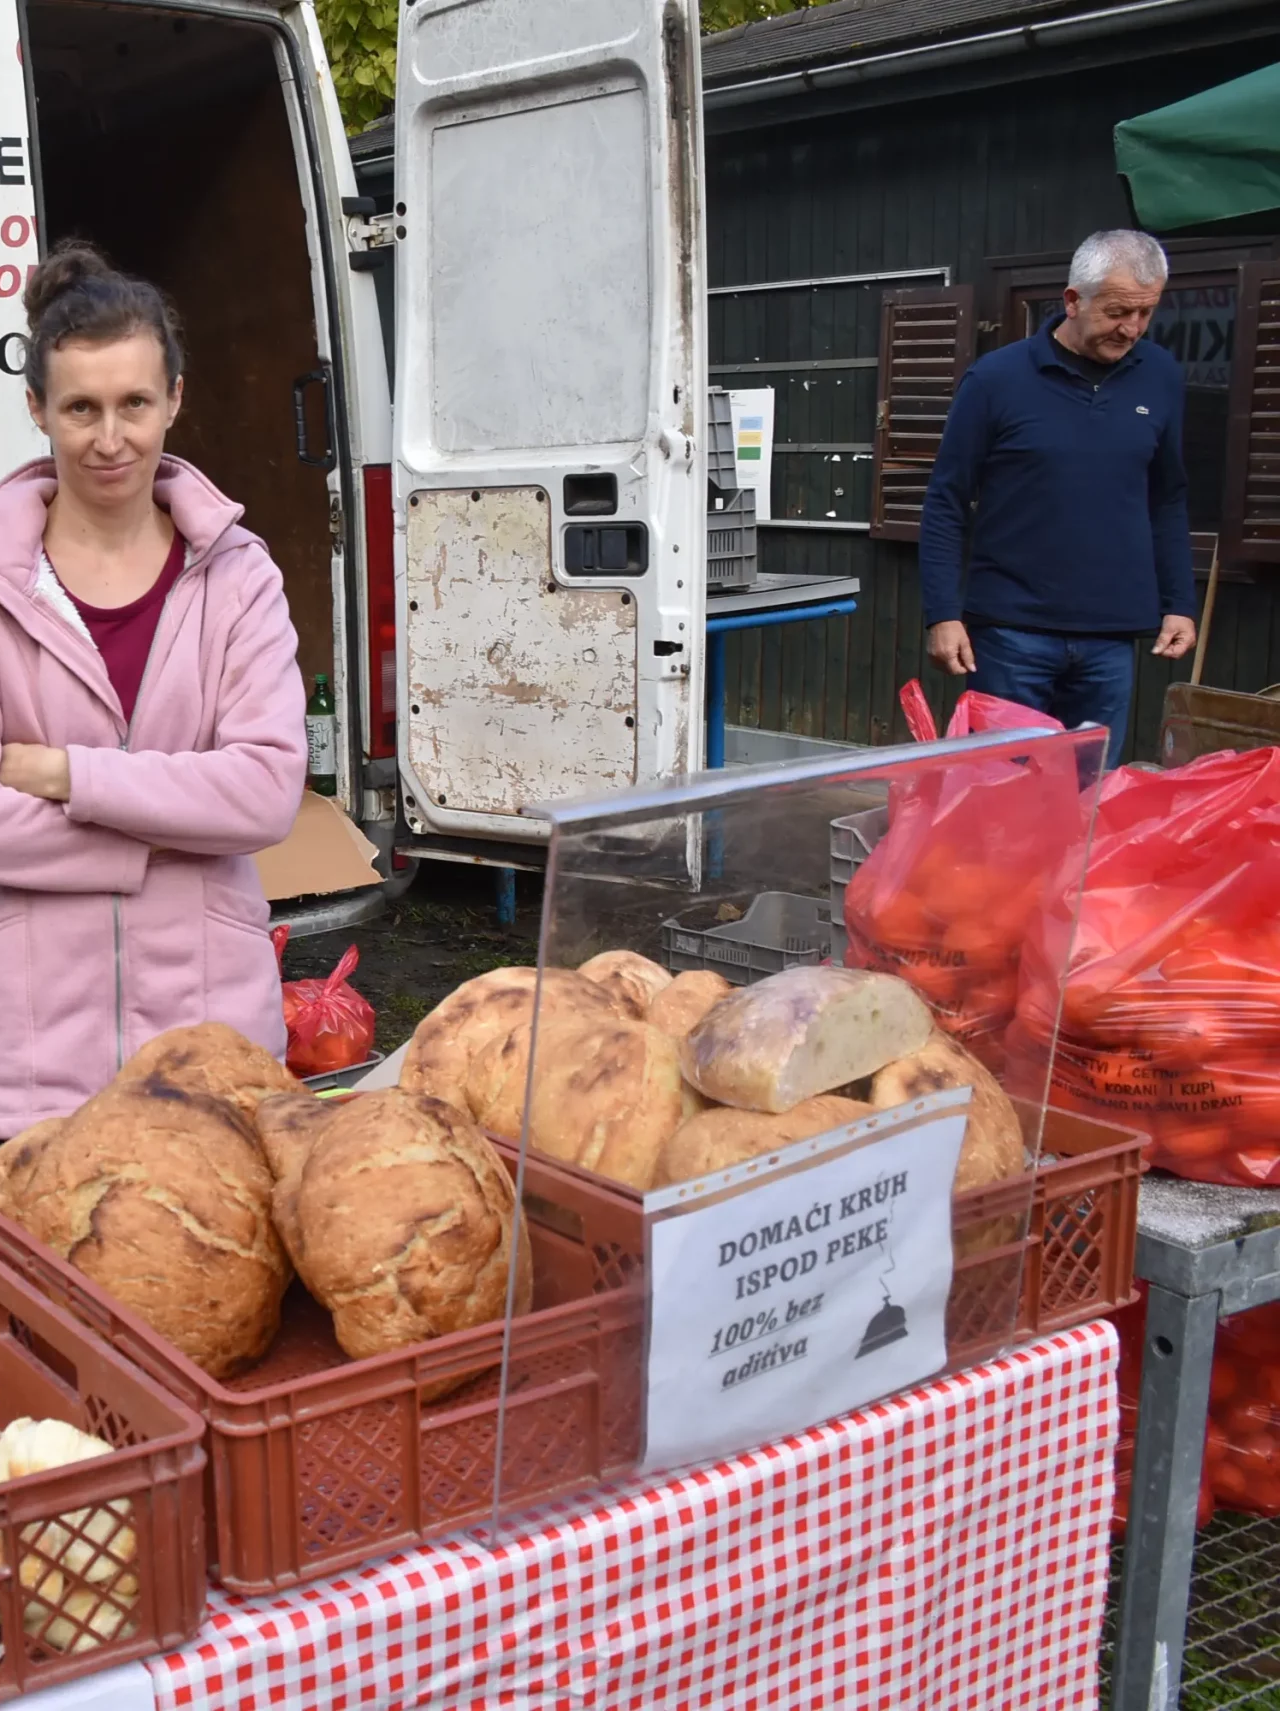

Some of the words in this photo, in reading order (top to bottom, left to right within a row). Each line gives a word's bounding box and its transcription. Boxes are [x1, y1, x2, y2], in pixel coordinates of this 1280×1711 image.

[1105, 1082, 1158, 1096] KORANI
[1181, 1080, 1216, 1096] KUPI
[718, 1202, 832, 1267] DOMAĆI
[839, 1171, 909, 1219] KRUH
[735, 1250, 818, 1300] ISPOD
[826, 1218, 889, 1265] PEKE
[710, 1308, 778, 1355] 100%
[785, 1293, 825, 1324] bez
[721, 1337, 808, 1388] aditiva
